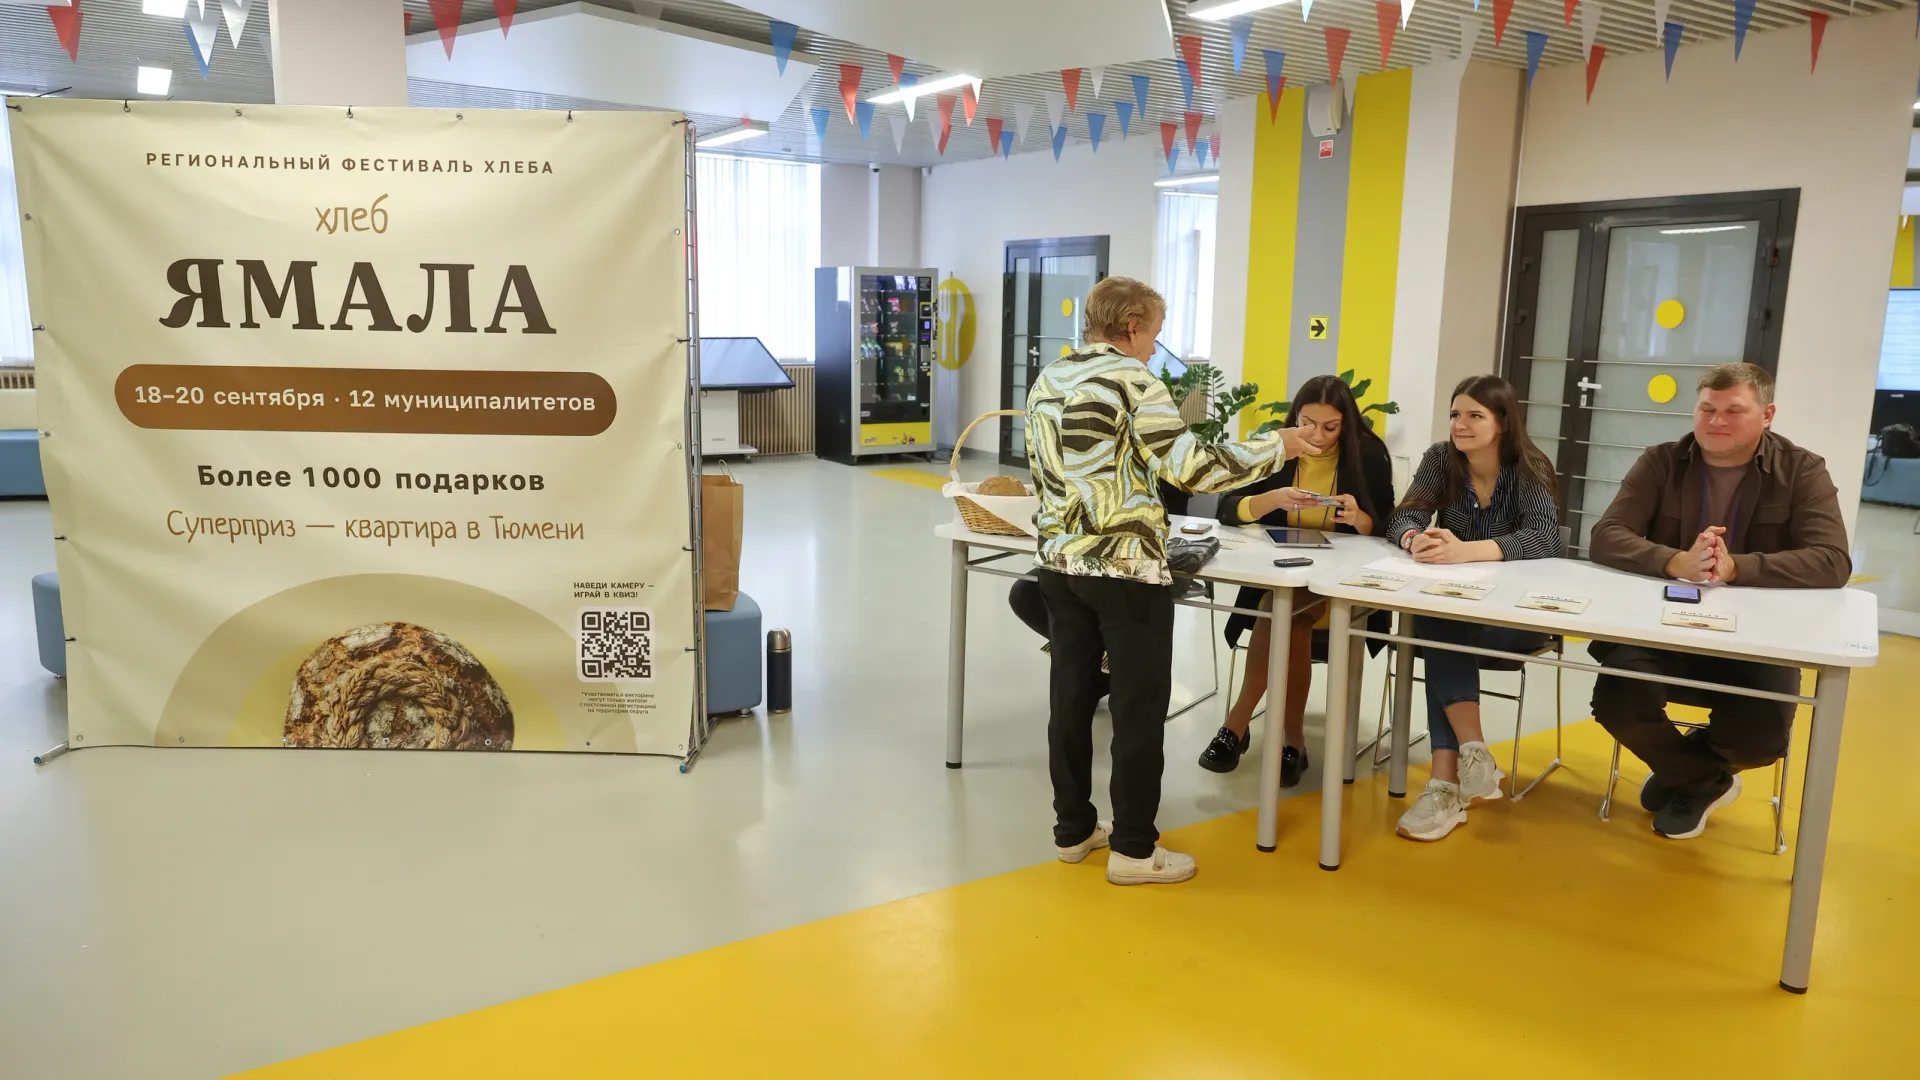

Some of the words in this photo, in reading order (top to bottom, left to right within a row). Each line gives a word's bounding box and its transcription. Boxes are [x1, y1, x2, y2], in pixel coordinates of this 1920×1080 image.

[145, 152, 330, 171] РЕГИОНАЛЬНЫЙ
[341, 157, 474, 173] ФЕСТИВАЛЬ
[483, 160, 554, 174] ХЛЕБА
[315, 193, 389, 235] хлеб
[158, 257, 558, 335] ЯМАЛА
[213, 388, 325, 411] сентября
[349, 389, 376, 408] 12
[384, 392, 596, 413] муниципалитетов
[197, 464, 292, 488] Более
[302, 466, 382, 490] 1000
[395, 472, 545, 496] подарков
[166, 509, 297, 545] Суперприз
[345, 518, 458, 548] квартира
[466, 520, 481, 540] в
[488, 514, 585, 541] Тюмени
[574, 590, 601, 598] ИГРАЙ
